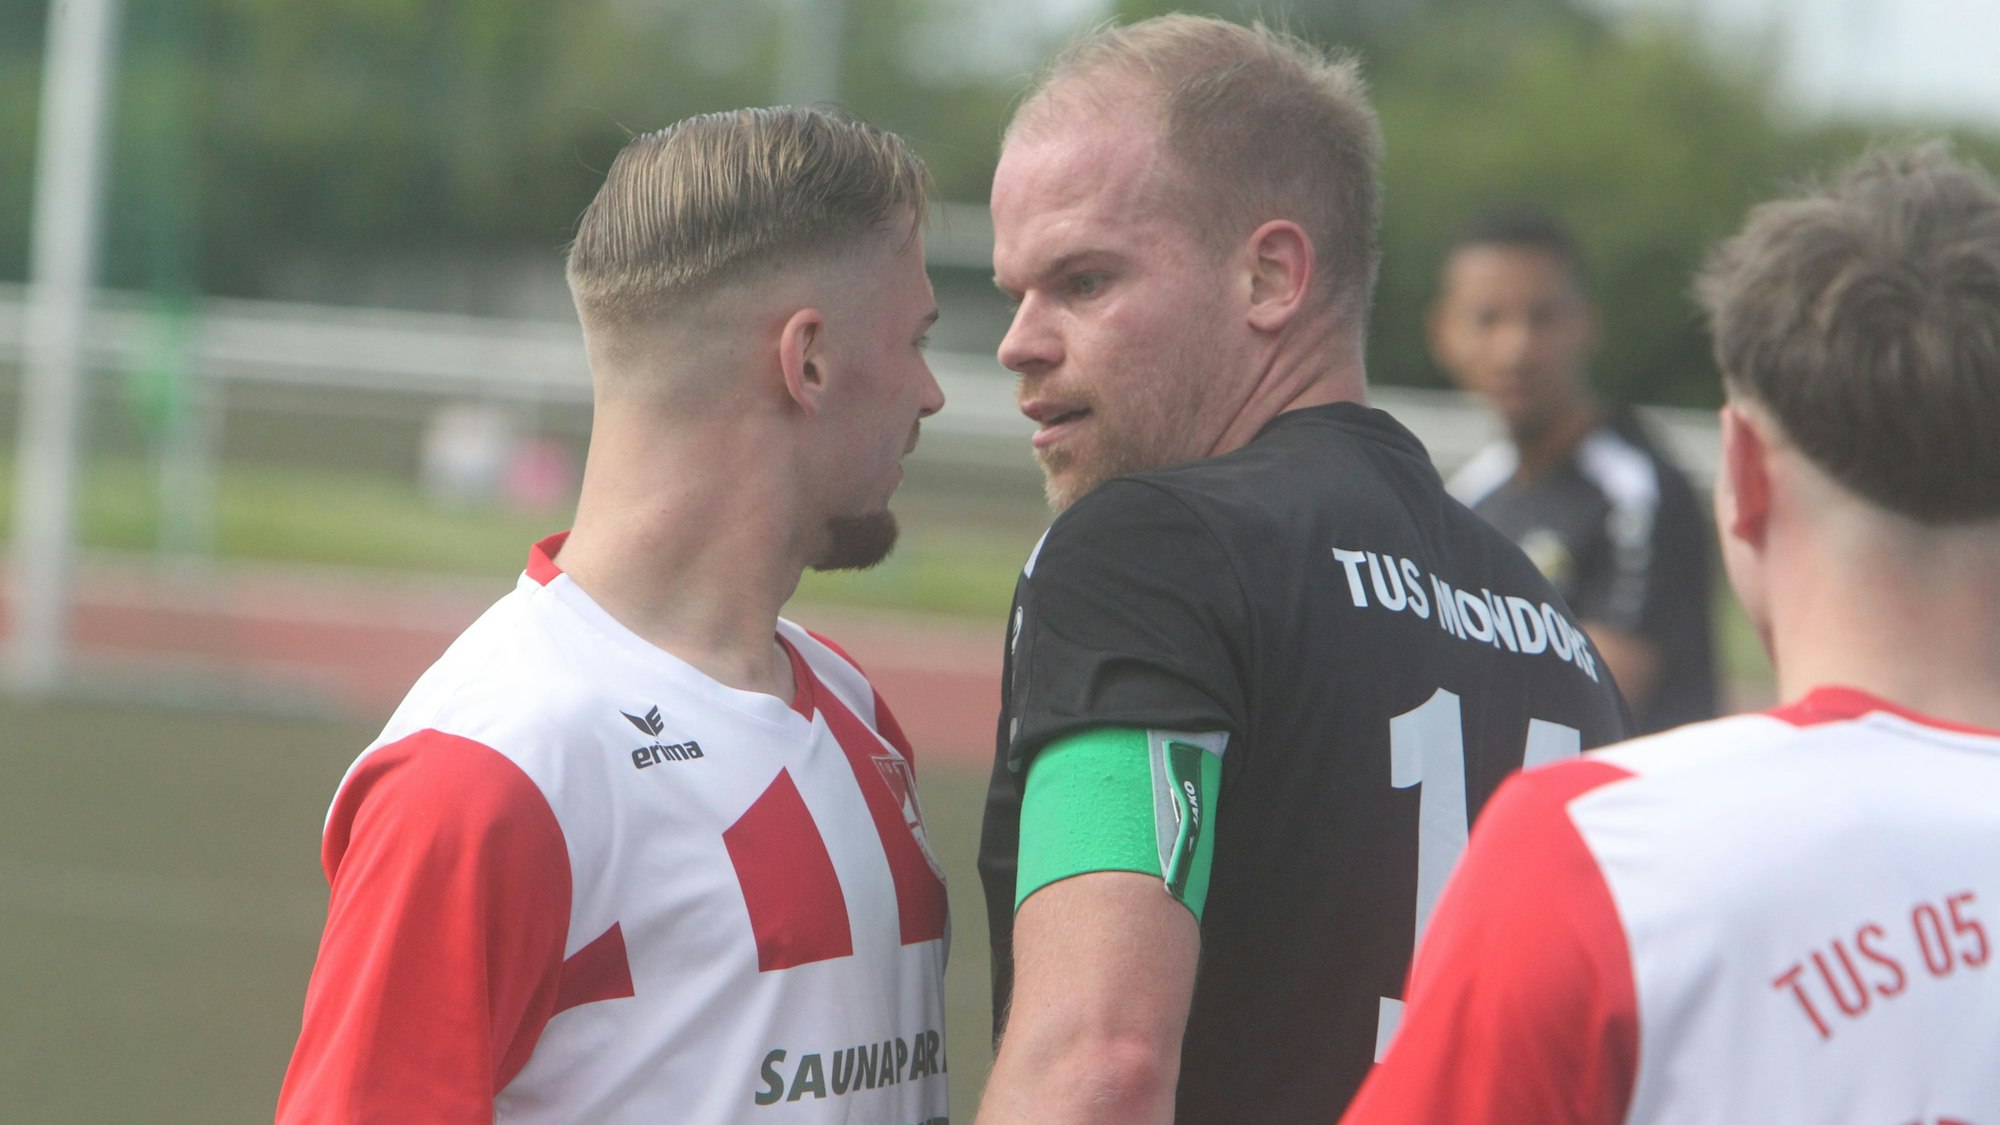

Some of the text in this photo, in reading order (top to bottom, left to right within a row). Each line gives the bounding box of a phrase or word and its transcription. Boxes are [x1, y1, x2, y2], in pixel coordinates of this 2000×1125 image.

[1332, 547, 1430, 619] TUS
[631, 740, 704, 770] erima
[1374, 687, 1582, 1064] 1
[1771, 890, 1991, 1040] TUS 05
